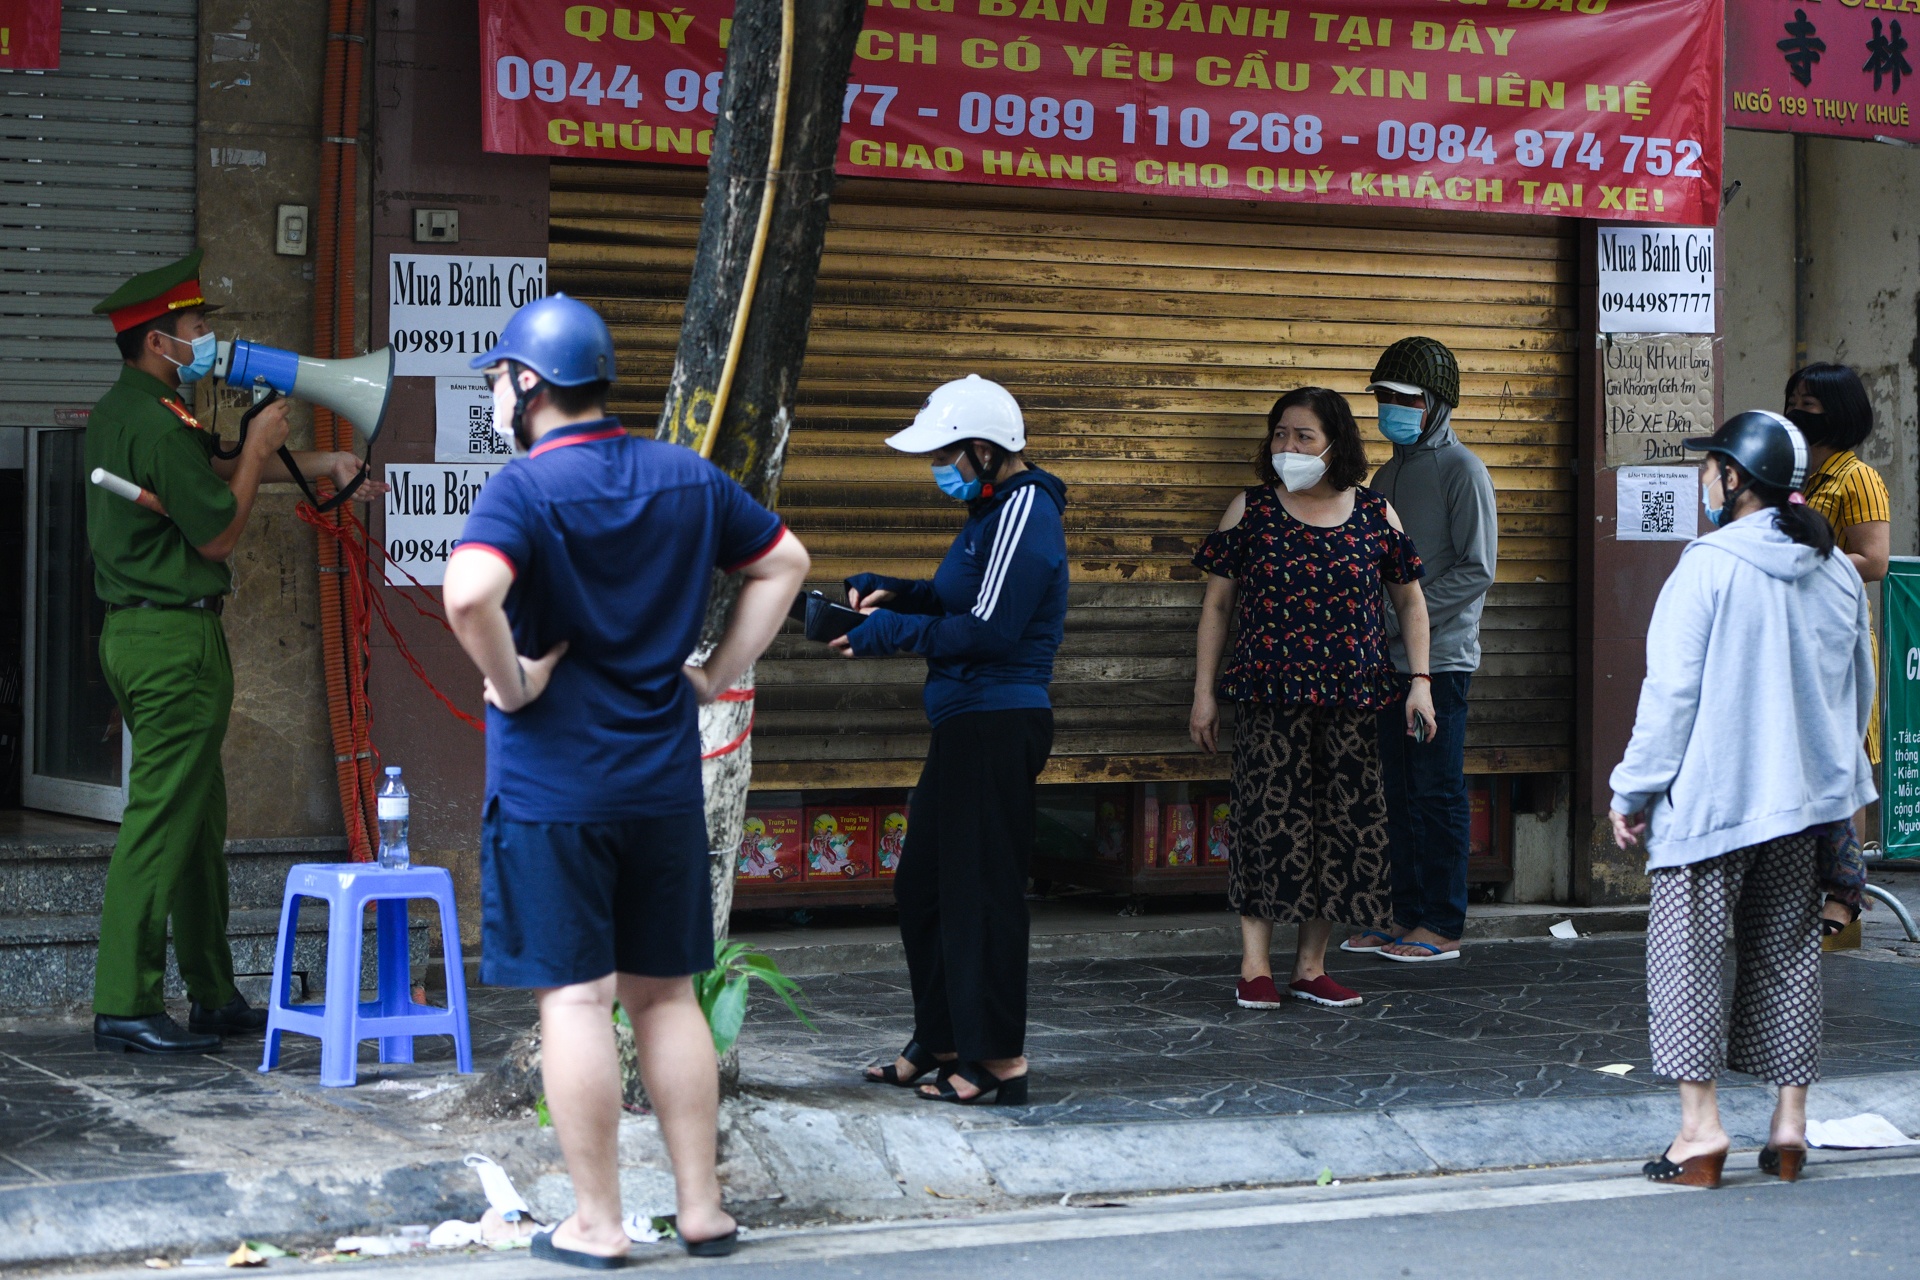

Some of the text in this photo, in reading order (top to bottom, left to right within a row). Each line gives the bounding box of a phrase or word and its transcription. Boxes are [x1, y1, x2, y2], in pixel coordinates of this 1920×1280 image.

[1309, 12, 1393, 51] TẠI
[1410, 18, 1517, 57] ĐÂY
[564, 5, 696, 45] QUÝ
[961, 35, 1041, 72] CÓ
[1062, 42, 1174, 83] YÊU
[1195, 49, 1310, 92] CẦU
[1329, 65, 1427, 101] XIN
[1447, 71, 1566, 111] LIÊN
[1585, 80, 1652, 121] HỆ
[496, 55, 643, 109] 0944
[664, 68, 728, 115] 98
[841, 82, 899, 127] 77
[958, 91, 1095, 141] 0989
[1115, 103, 1210, 148] 110
[1227, 110, 1323, 155] 268
[1376, 119, 1498, 166] 0984
[1514, 129, 1605, 172] 874
[1619, 134, 1703, 179] 752
[1733, 87, 1910, 126] NGÕ 199 THỤY KHUÊ
[849, 139, 964, 172] GIAO
[982, 146, 1118, 183] HÀNG
[1135, 159, 1229, 189] CHO
[1246, 164, 1336, 194] QUÝ
[1350, 171, 1503, 204] KHÁCH
[1518, 180, 1583, 211] TẠI
[1598, 184, 1665, 212] XE!
[1600, 232, 1712, 284] Mua Bánh Gọi
[393, 260, 441, 307] Mua
[448, 261, 501, 308] Bánh
[1602, 292, 1711, 313] 0944987777
[394, 329, 504, 354] 0989110
[1647, 345, 1664, 370] KH
[1680, 378, 1695, 394] 1m
[1609, 404, 1692, 434] Để XE Bên
[389, 469, 489, 516] Mua Bán
[1906, 646, 1920, 680] C
[1898, 728, 1912, 744] Tất
[1894, 748, 1919, 764] thông
[1897, 763, 1919, 780] Kiểm
